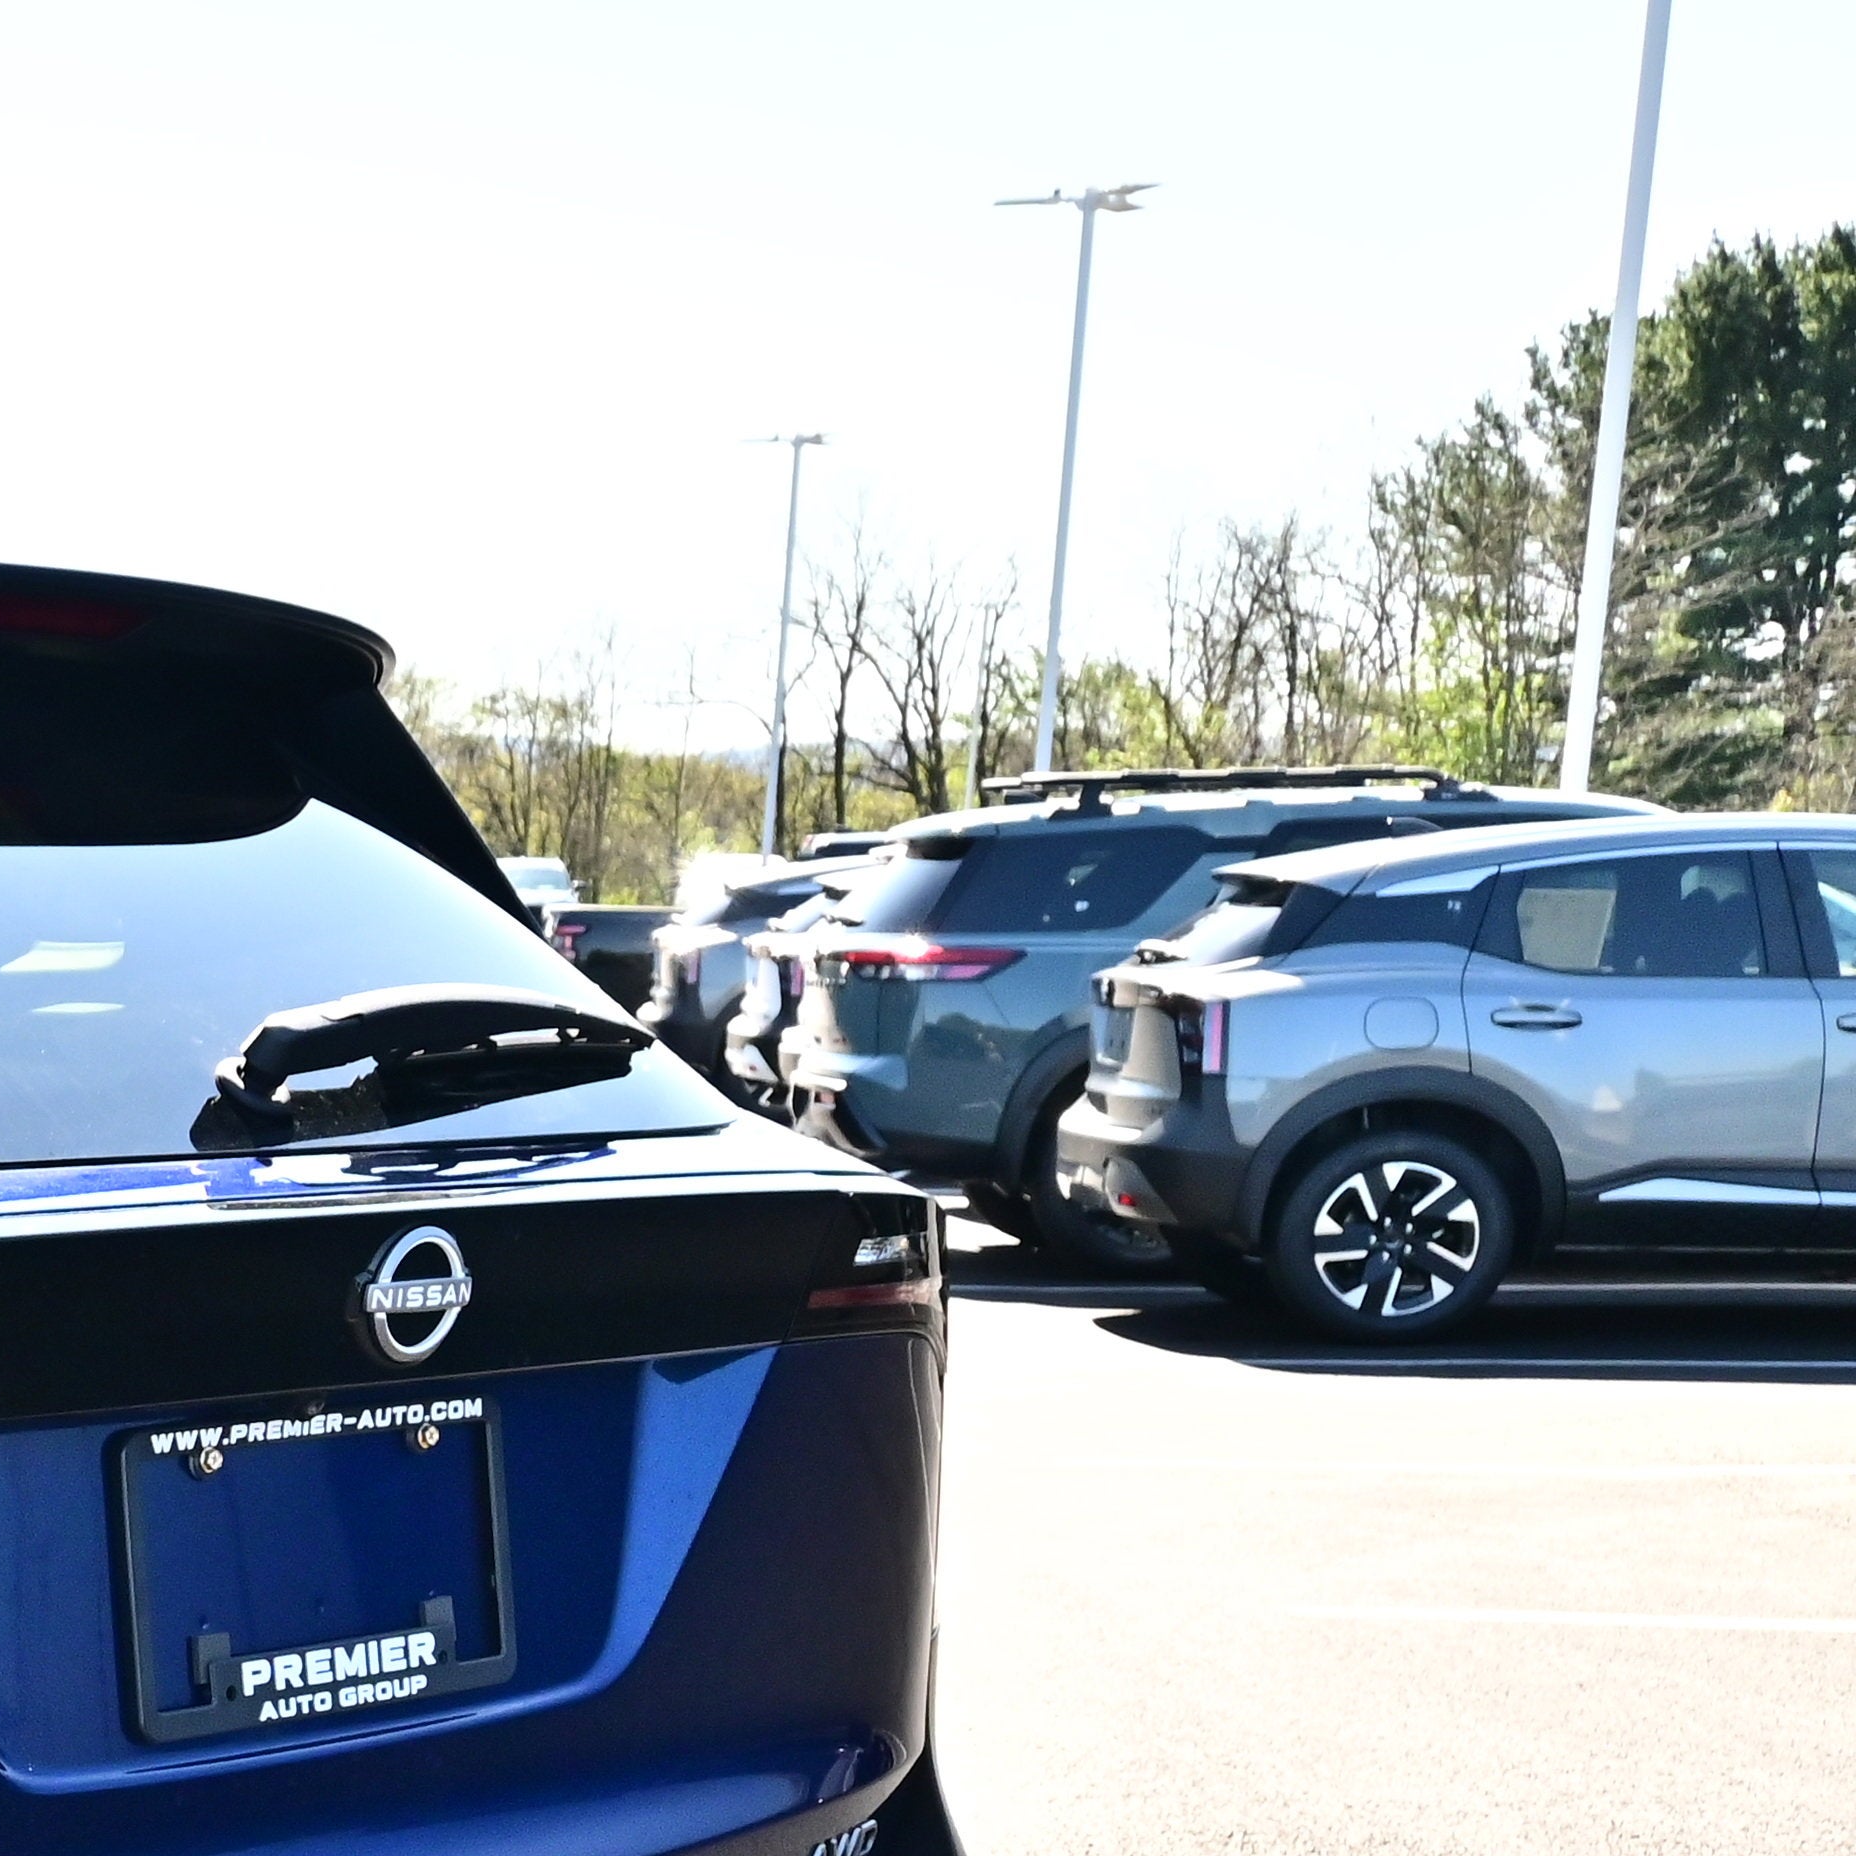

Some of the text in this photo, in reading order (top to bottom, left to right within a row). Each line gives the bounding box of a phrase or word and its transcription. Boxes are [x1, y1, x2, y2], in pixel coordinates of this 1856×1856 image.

[371, 1283, 471, 1309] NISSAN
[151, 1398, 483, 1454] WWW.PREMIER-AUTO.COM
[241, 1632, 437, 1697] PREMIER
[259, 1675, 428, 1722] AUTO GROUP
